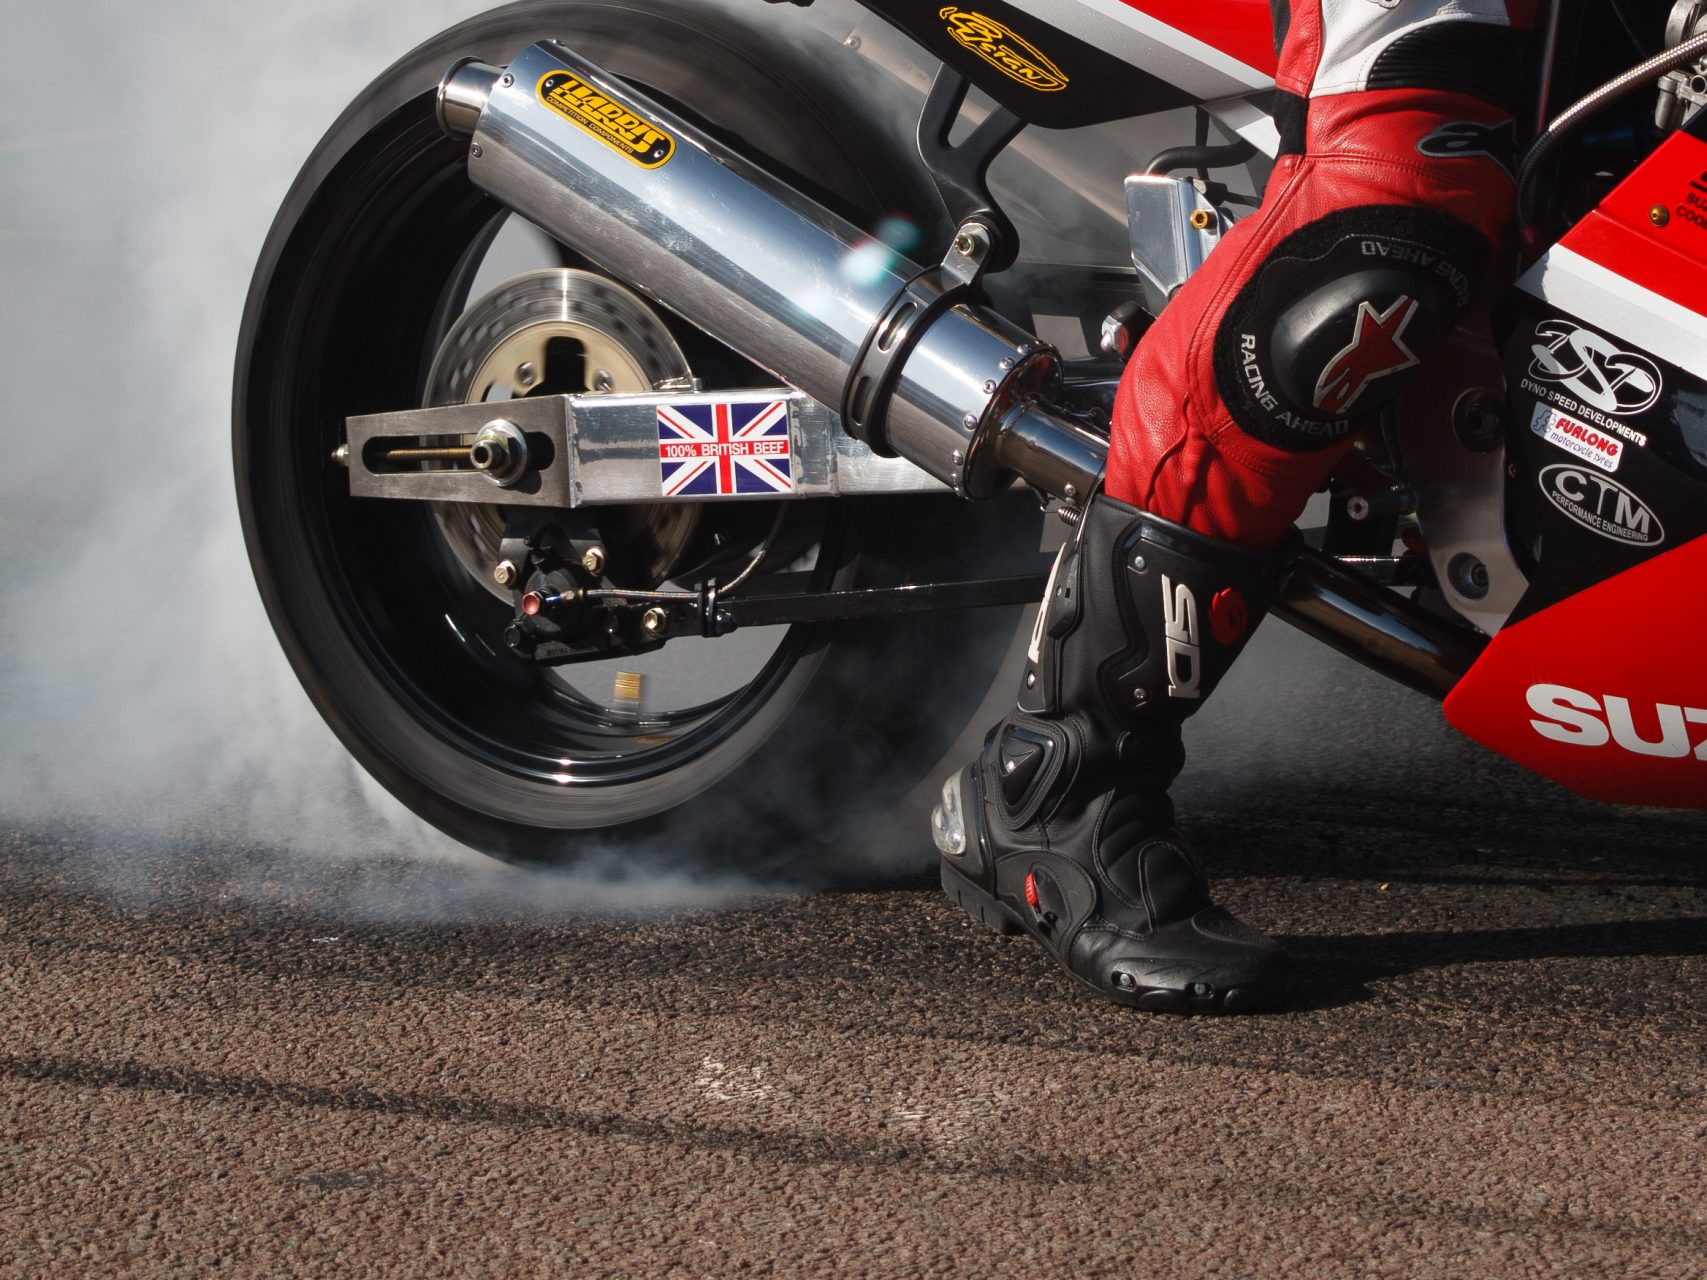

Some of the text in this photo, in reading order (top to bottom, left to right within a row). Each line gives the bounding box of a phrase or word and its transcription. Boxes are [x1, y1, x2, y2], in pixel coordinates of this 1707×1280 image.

[545, 96, 635, 155] COMPETITION COMPONENTS
[549, 78, 666, 154] HARRIS
[1360, 240, 1438, 267] AHEAD
[1241, 332, 1349, 436] RACING AHEAD
[1520, 378, 1648, 448] DYNO SPEED DEVELOPMENTS
[665, 441, 785, 458] 100% BRITISH BEEF
[1550, 431, 1614, 470] motorcycle tyres
[1555, 417, 1619, 457] FURLONG
[1552, 490, 1649, 542] PERFORMANCE ENGINEERING
[1555, 470, 1651, 534] CTM
[1161, 573, 1201, 700] SIDI
